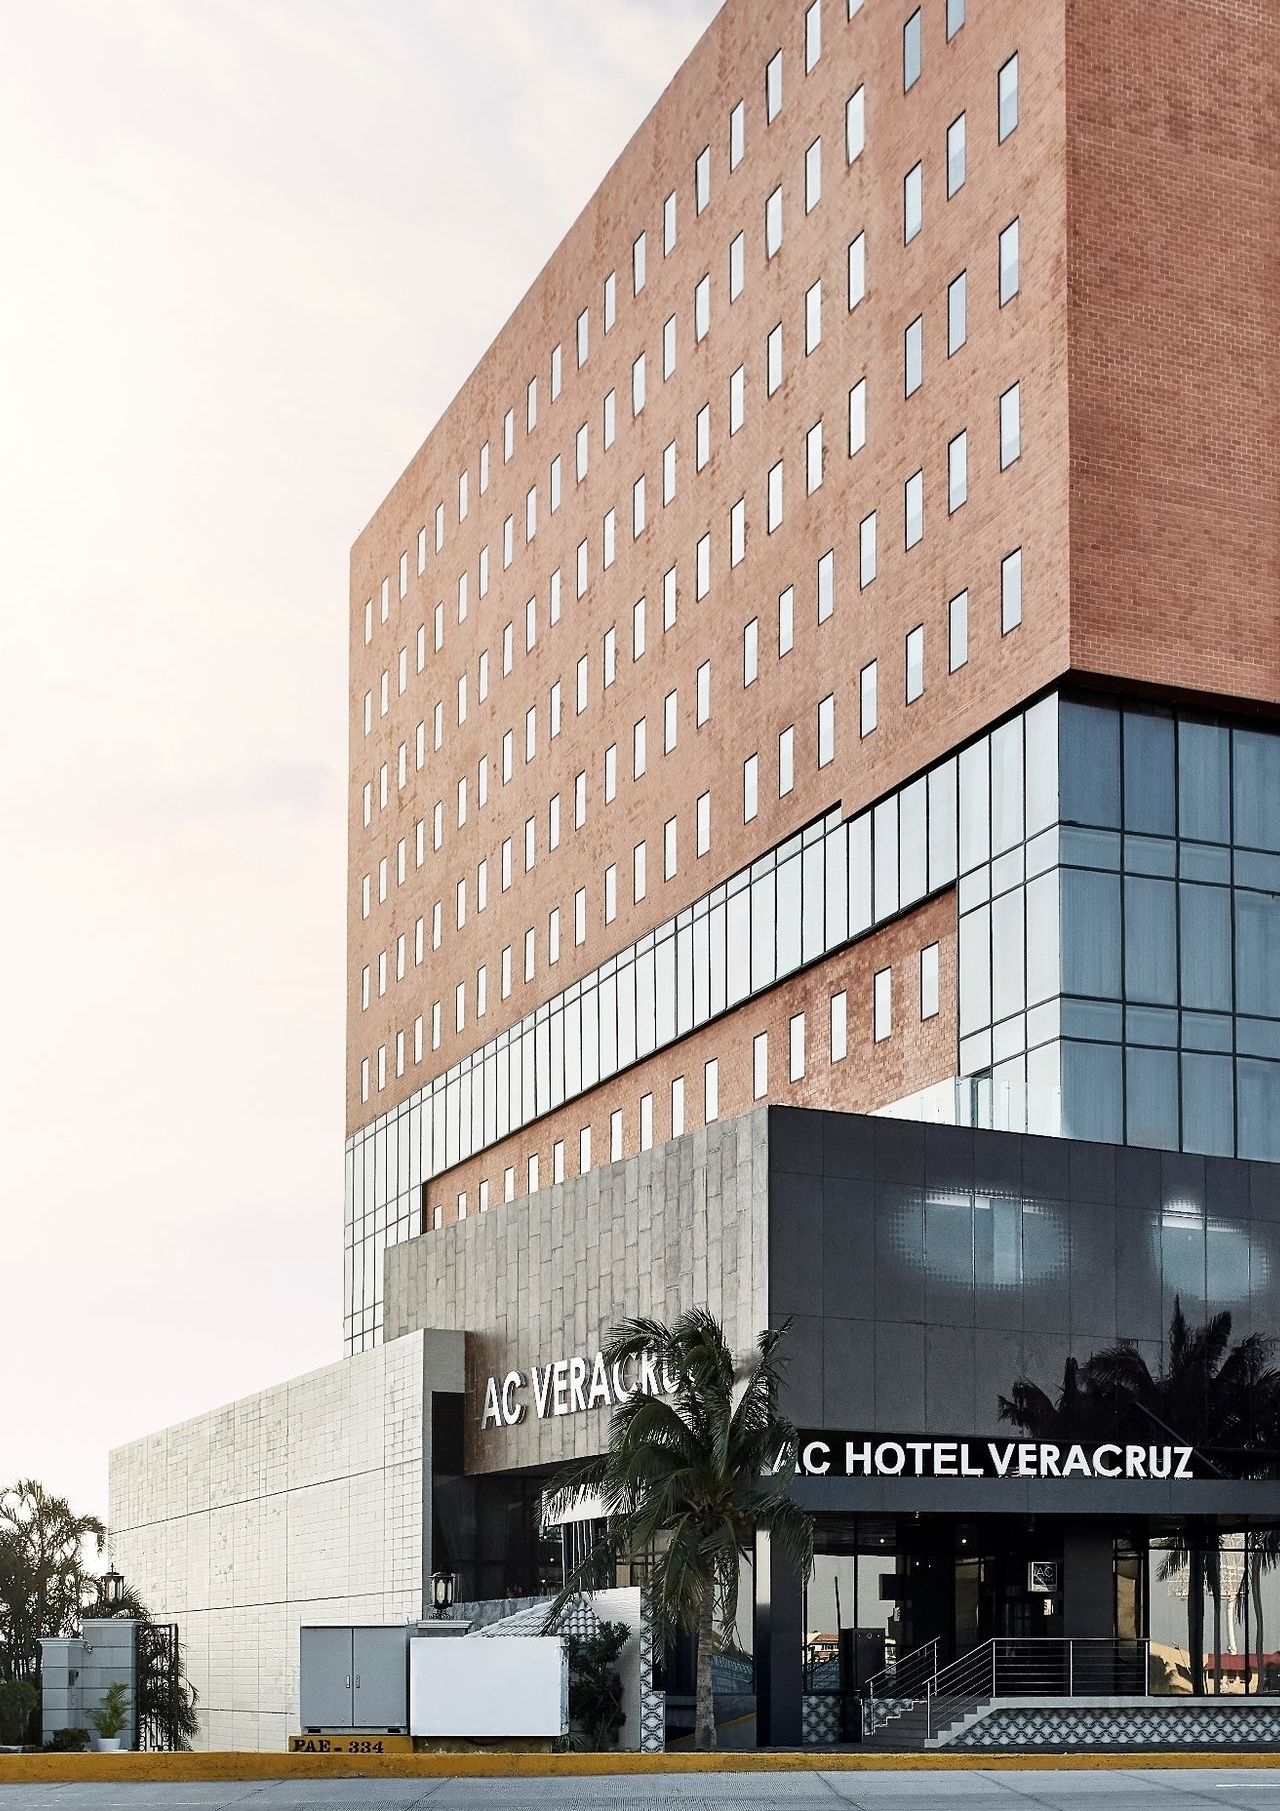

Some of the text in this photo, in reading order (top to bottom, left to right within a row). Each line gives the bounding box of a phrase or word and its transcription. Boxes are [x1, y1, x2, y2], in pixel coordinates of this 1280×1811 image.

[481, 1370, 526, 1430] AC
[845, 1441, 984, 1476] HOTEL
[987, 1443, 1194, 1479] VERACRUZ
[293, 1739, 331, 1753] PAE
[348, 1741, 384, 1754] 334
